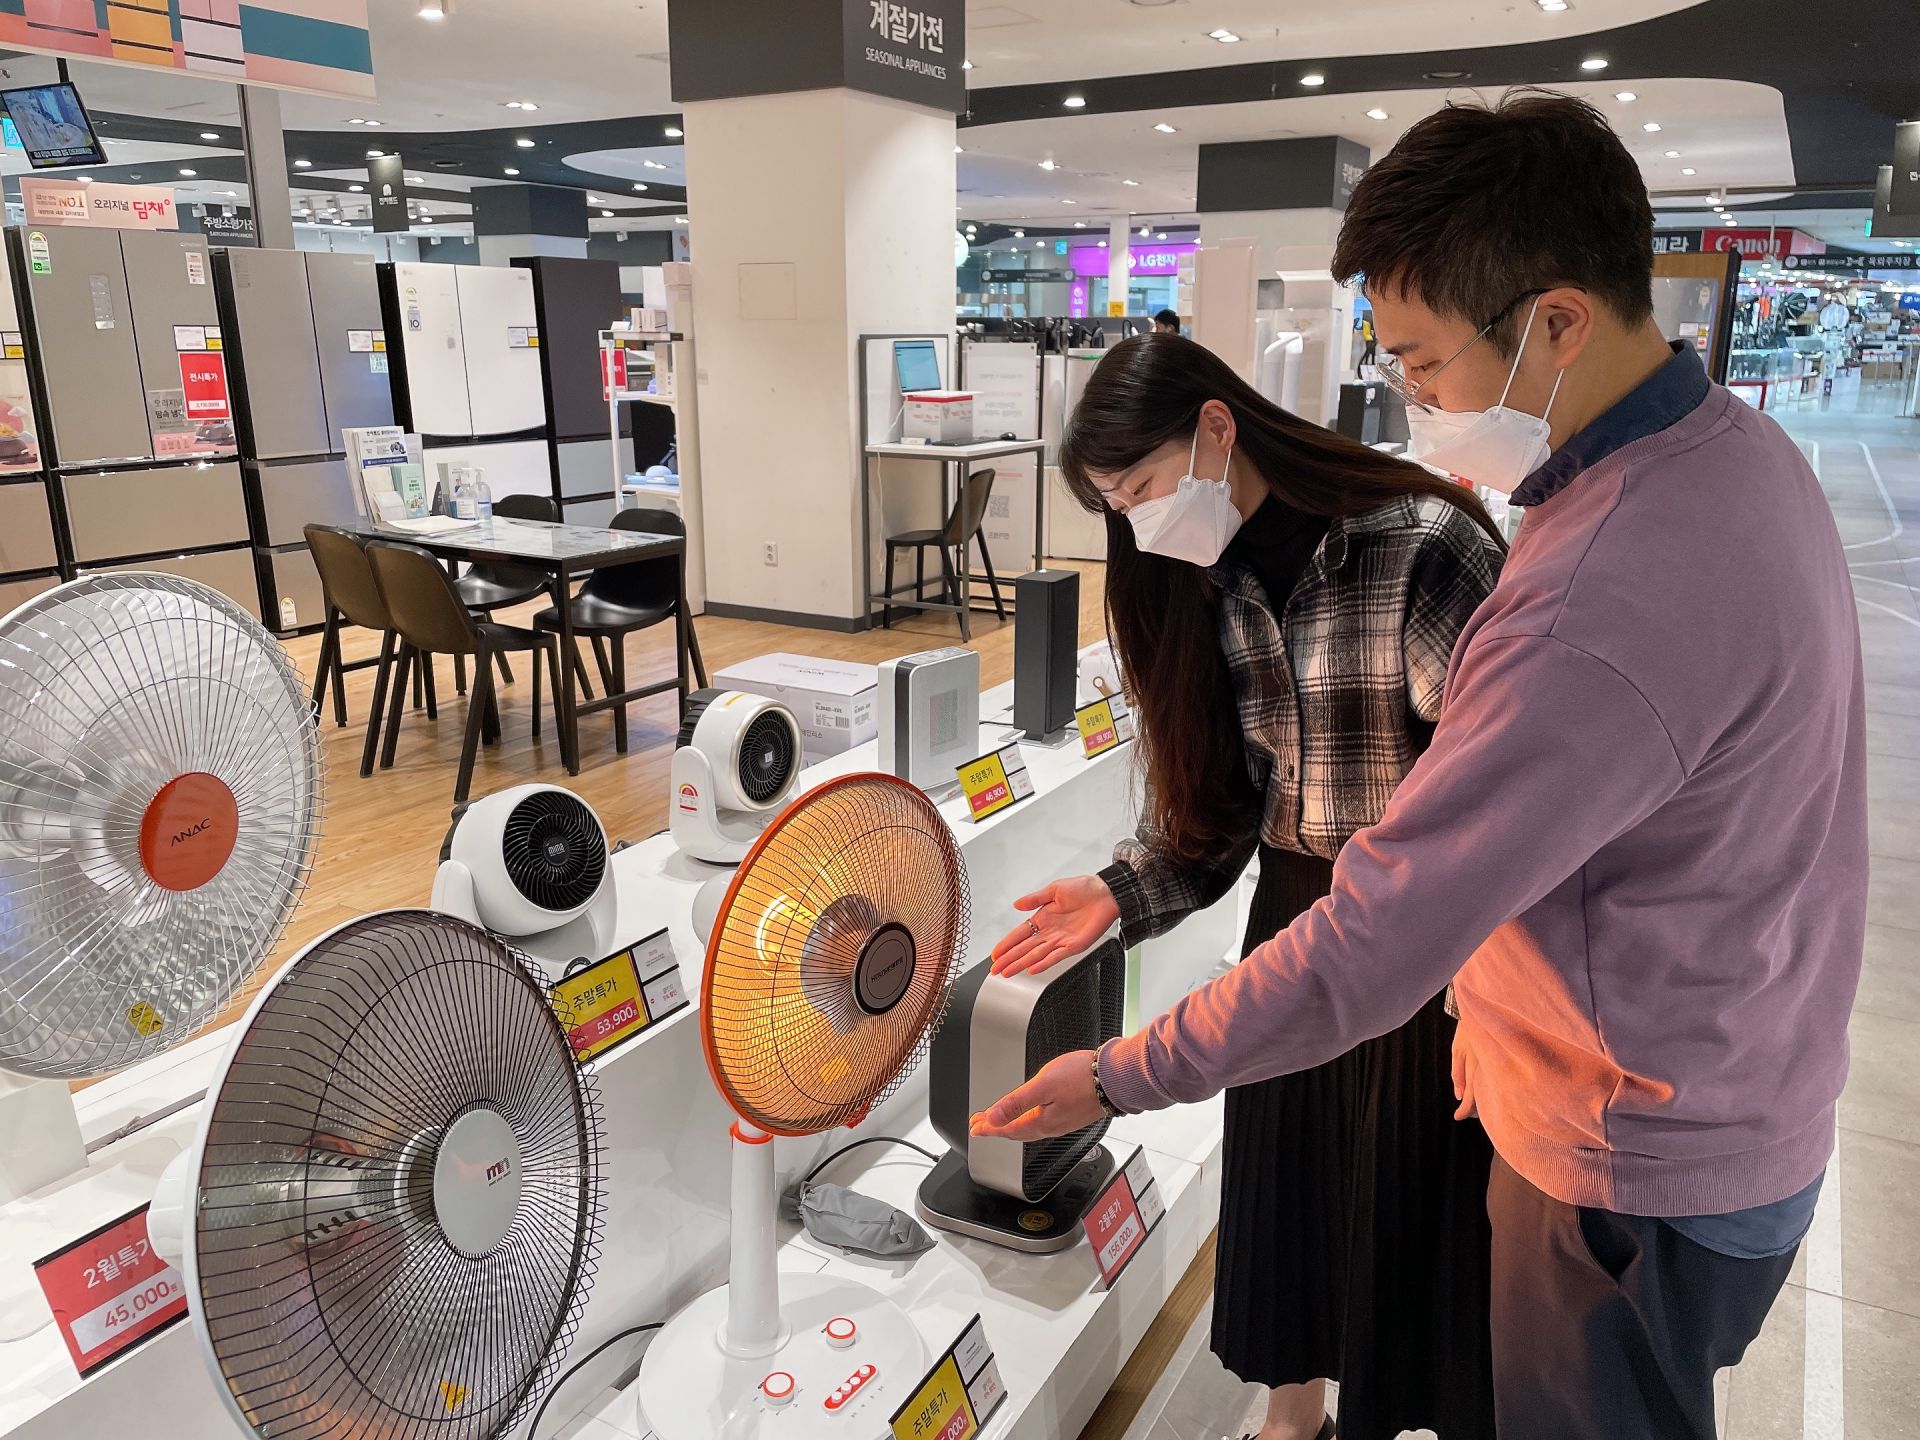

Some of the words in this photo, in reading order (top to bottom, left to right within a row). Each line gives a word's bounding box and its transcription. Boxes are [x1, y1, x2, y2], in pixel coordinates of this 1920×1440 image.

[869, 0, 943, 53] 계절가전
[865, 47, 904, 69] SEASONAL
[904, 57, 947, 79] APPLIANCES
[94, 199, 129, 212] 오리지널
[132, 201, 165, 220] 딤채
[409, 319, 420, 328] 10
[968, 766, 994, 785] 주말특가
[572, 976, 618, 1011] 주말특가
[596, 1006, 638, 1035] 53,900원
[1098, 1197, 1123, 1234] 2월특가
[104, 1281, 179, 1329] 45,000원
[912, 1387, 949, 1437] 주말특가
